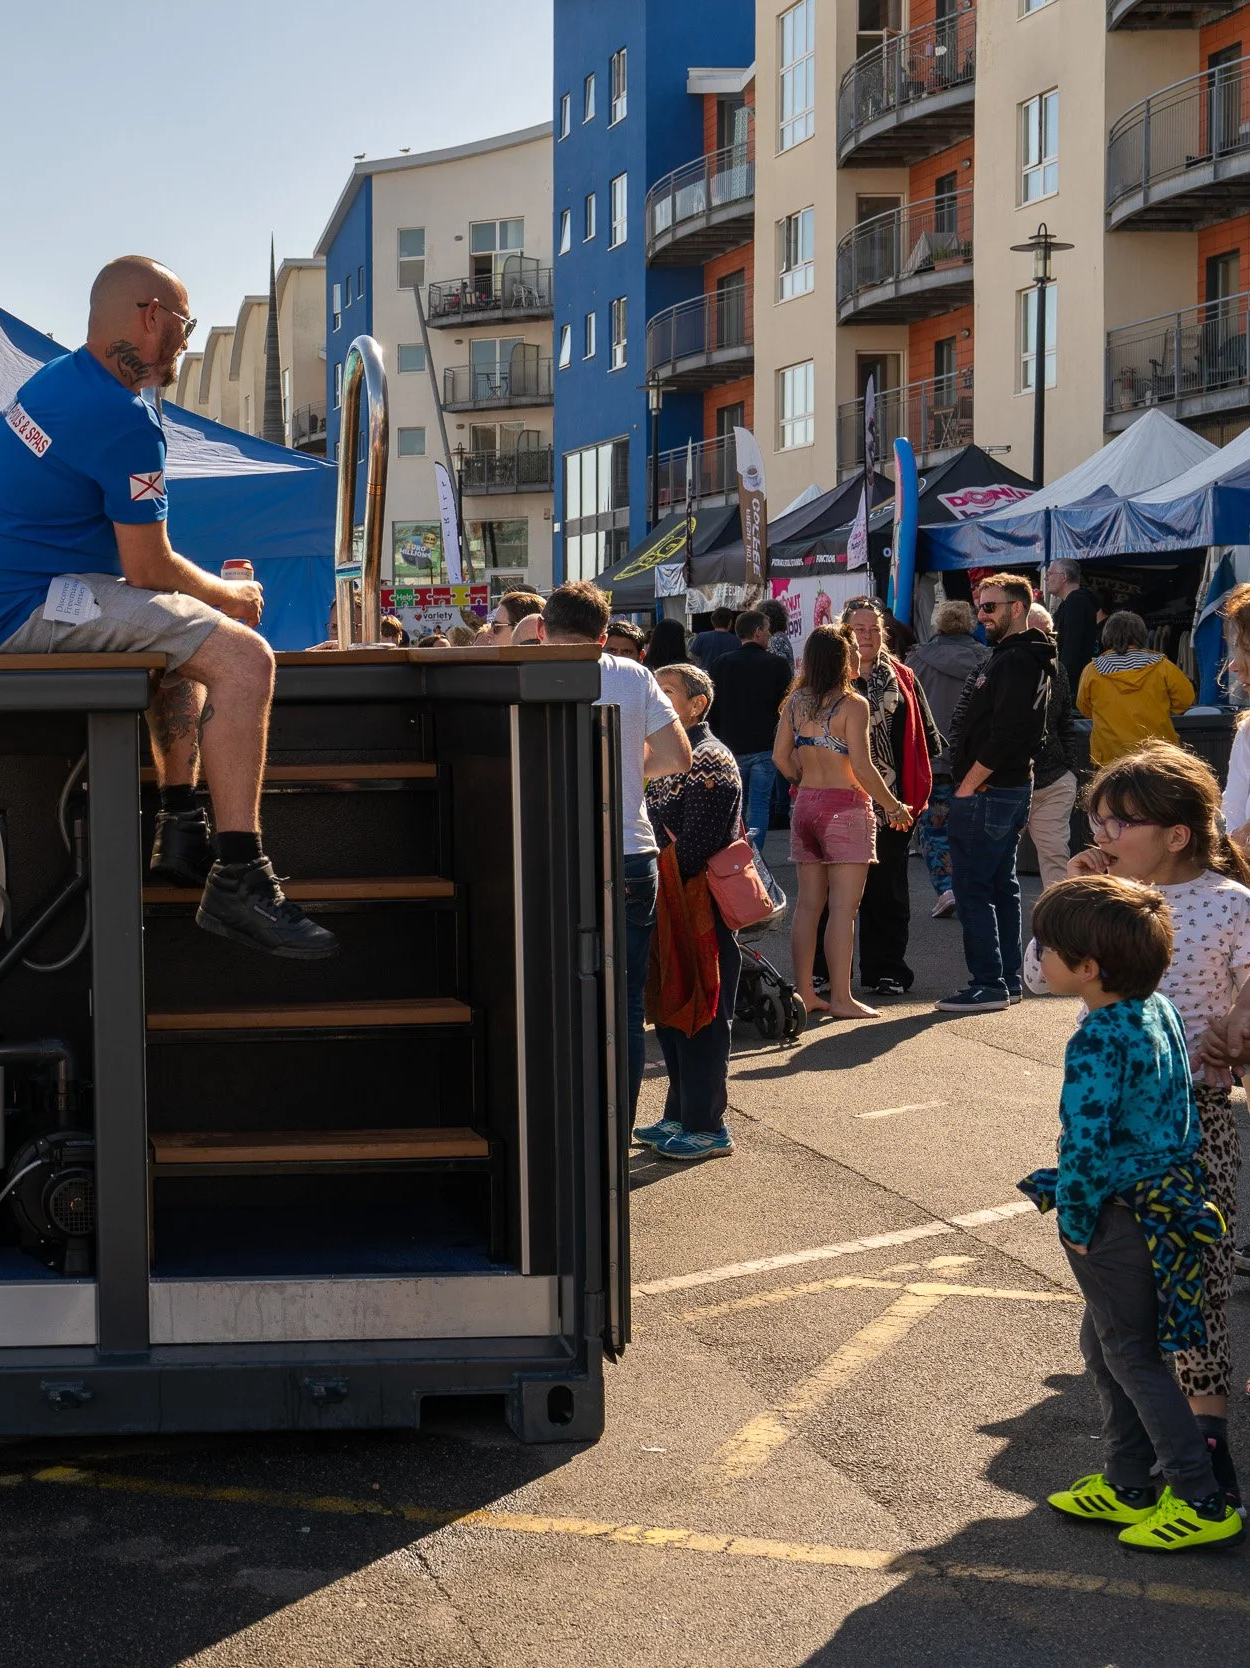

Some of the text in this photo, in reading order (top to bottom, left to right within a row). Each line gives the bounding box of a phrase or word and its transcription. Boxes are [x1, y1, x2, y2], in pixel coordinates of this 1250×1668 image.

[18, 420, 30, 435] &
[25, 427, 49, 454] SPAS
[55, 582, 70, 613] Discover
[74, 587, 86, 616] in Jersey
[396, 593, 413, 601] Help
[422, 611, 453, 621] variety
